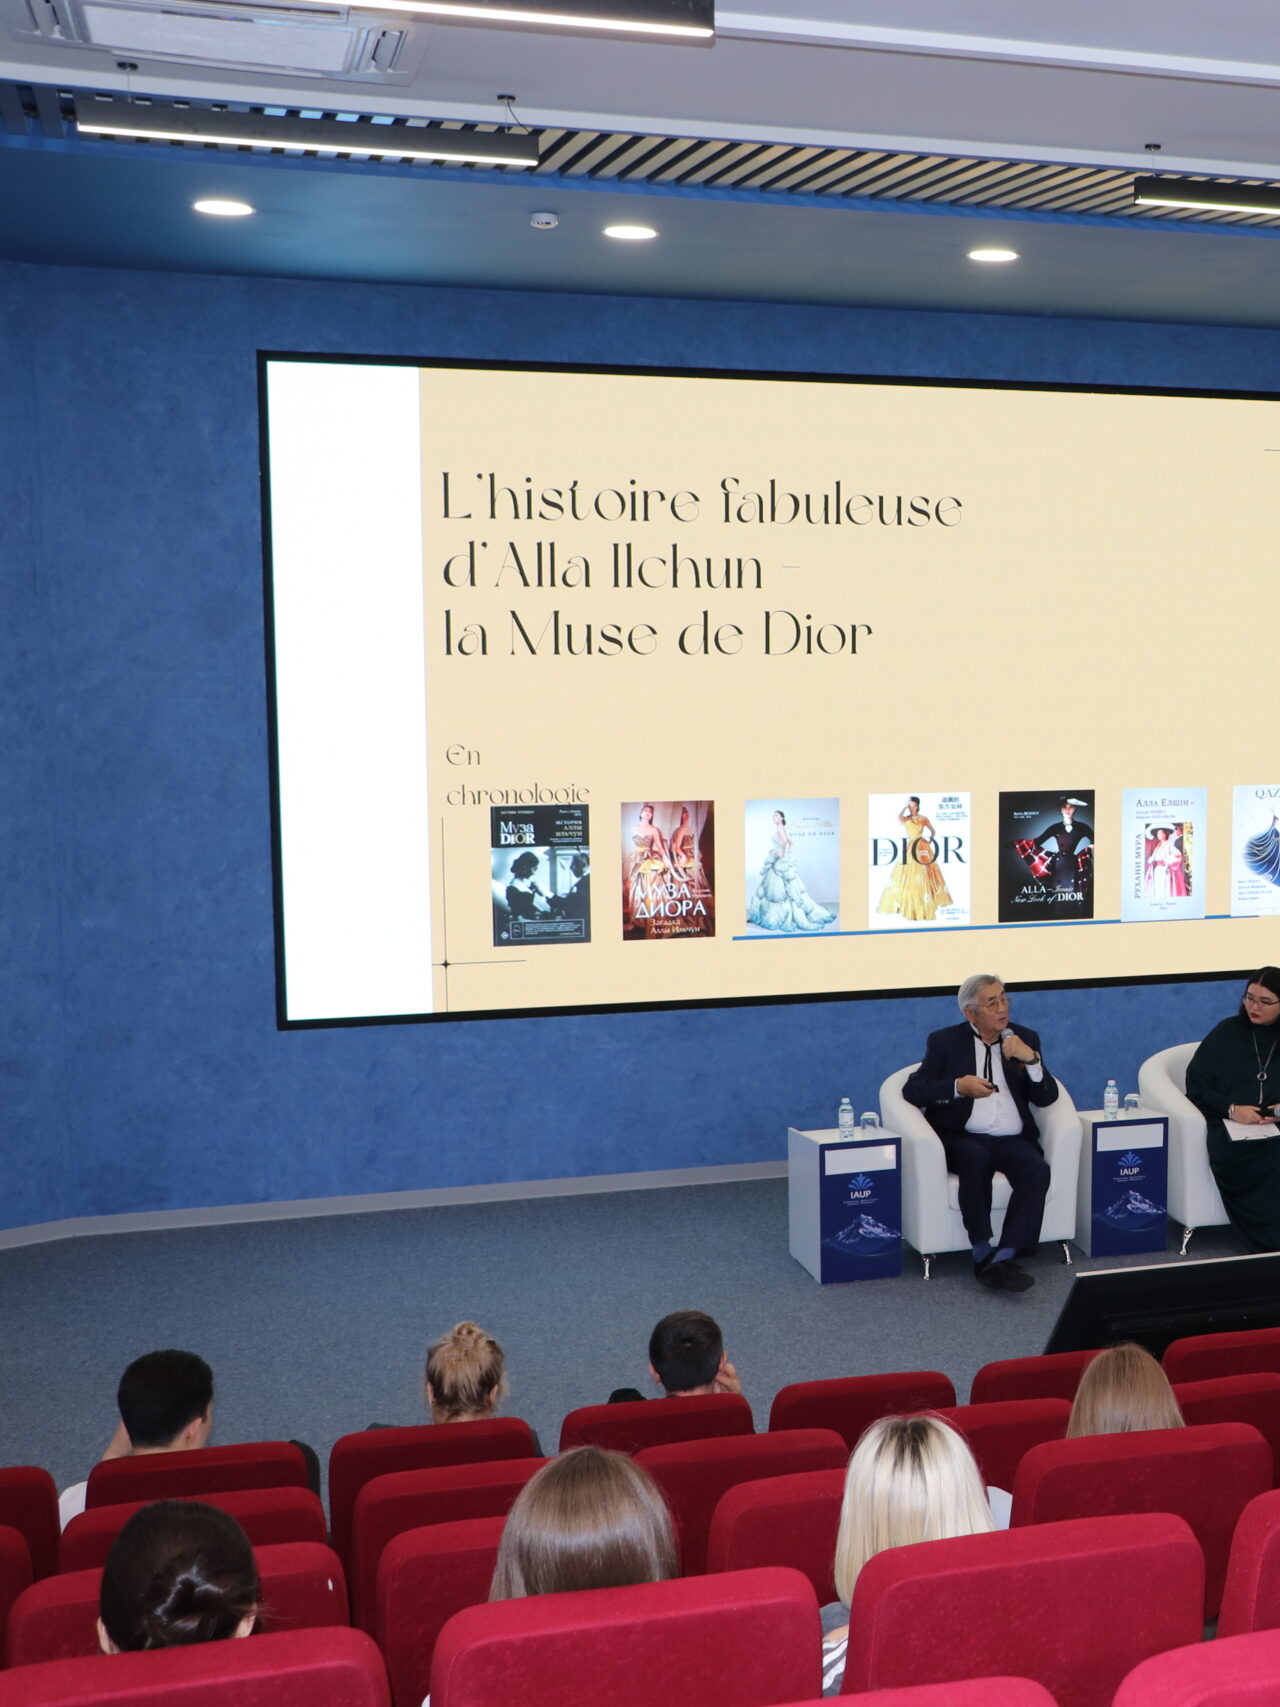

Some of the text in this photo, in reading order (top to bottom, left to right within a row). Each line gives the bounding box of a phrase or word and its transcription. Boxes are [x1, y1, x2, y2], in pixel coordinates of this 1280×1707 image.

[441, 471, 963, 527] L'histoire fabuleuse
[442, 540, 592, 588] d'Alla
[612, 542, 764, 589] Ilchun
[444, 609, 873, 656] la Muse de Dior
[445, 743, 481, 766] En
[446, 782, 590, 808] chronologie
[871, 836, 967, 866] DIOR
[634, 882, 692, 900] МУЗА
[1021, 885, 1046, 894] ALLA
[1057, 892, 1084, 902] DIOR
[635, 899, 707, 918] ДИОРА
[1120, 1167, 1140, 1176] IAUP
[850, 1190, 872, 1199] IAUP
